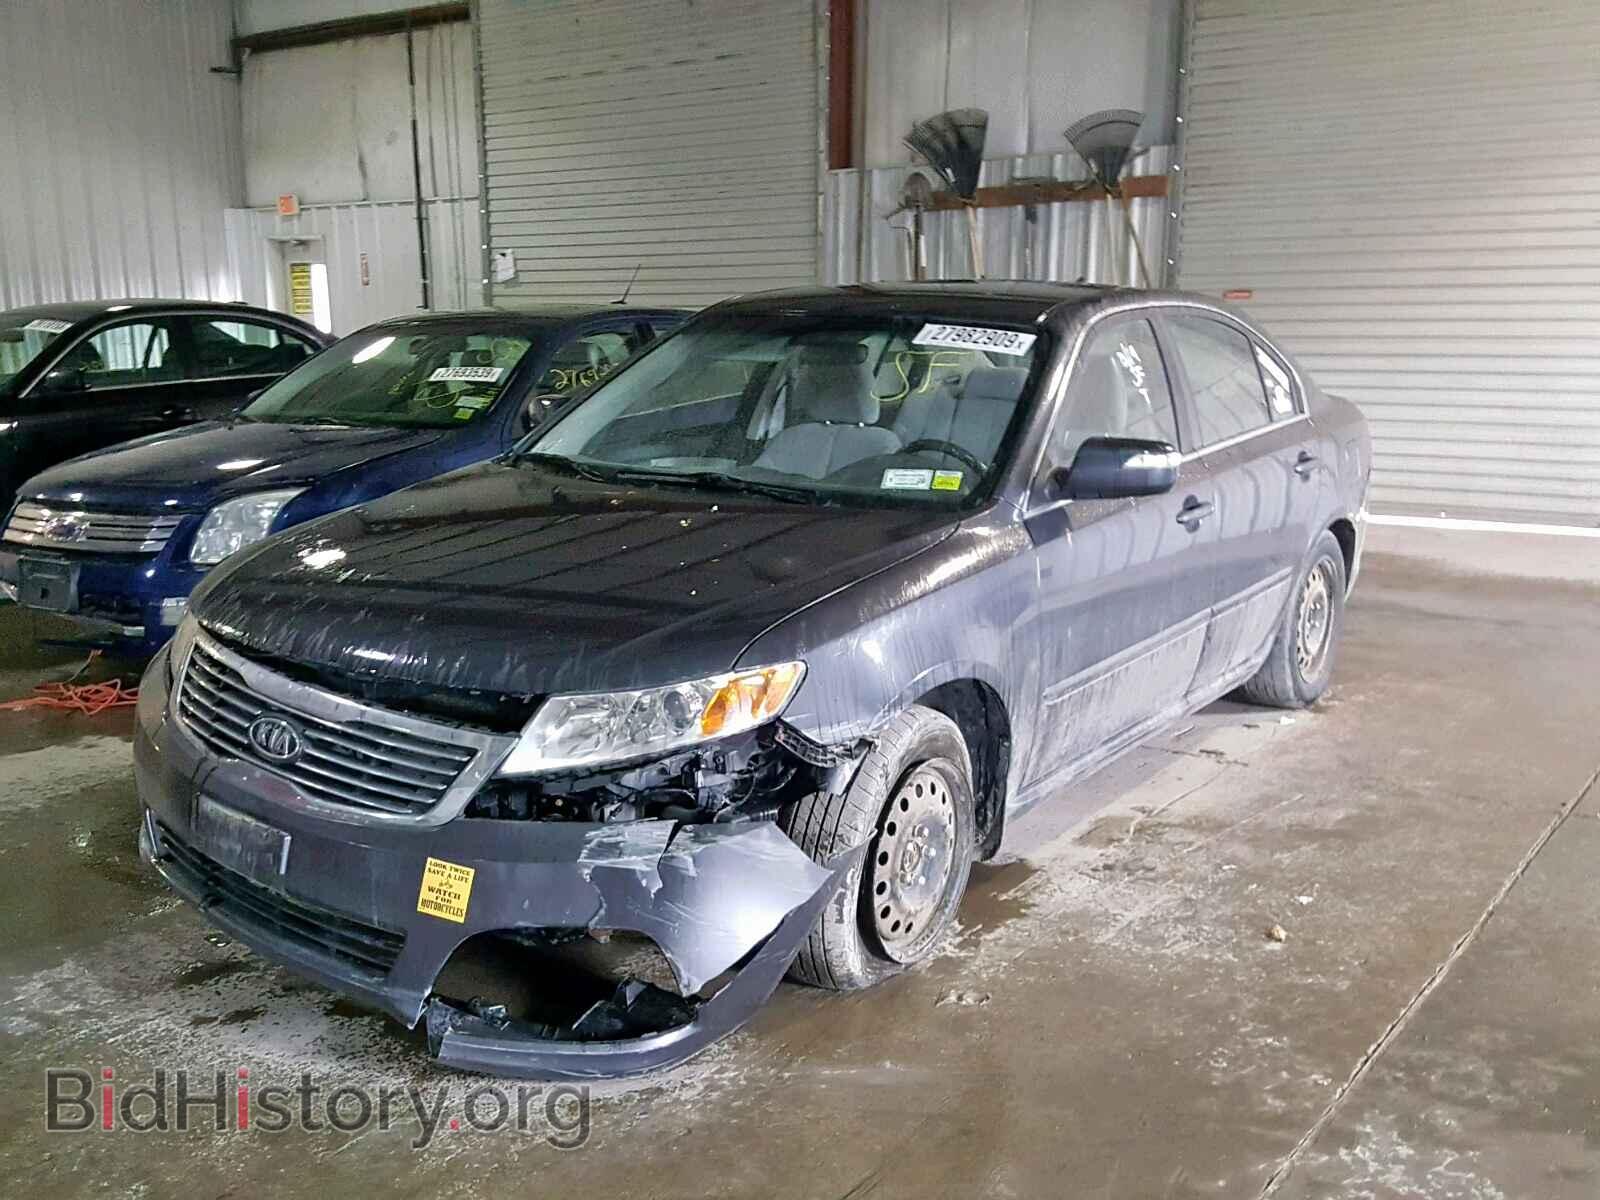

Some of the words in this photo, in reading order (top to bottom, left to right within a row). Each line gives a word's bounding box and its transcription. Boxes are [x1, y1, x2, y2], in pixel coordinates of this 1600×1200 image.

[428, 867, 445, 877] SAVE
[454, 874, 469, 883] LIFE
[429, 860, 447, 870] LOOK
[449, 865, 470, 876] TWICE
[428, 886, 461, 900] WATCH
[435, 895, 452, 904] FOR
[421, 898, 464, 917] MOTORCYCLES
